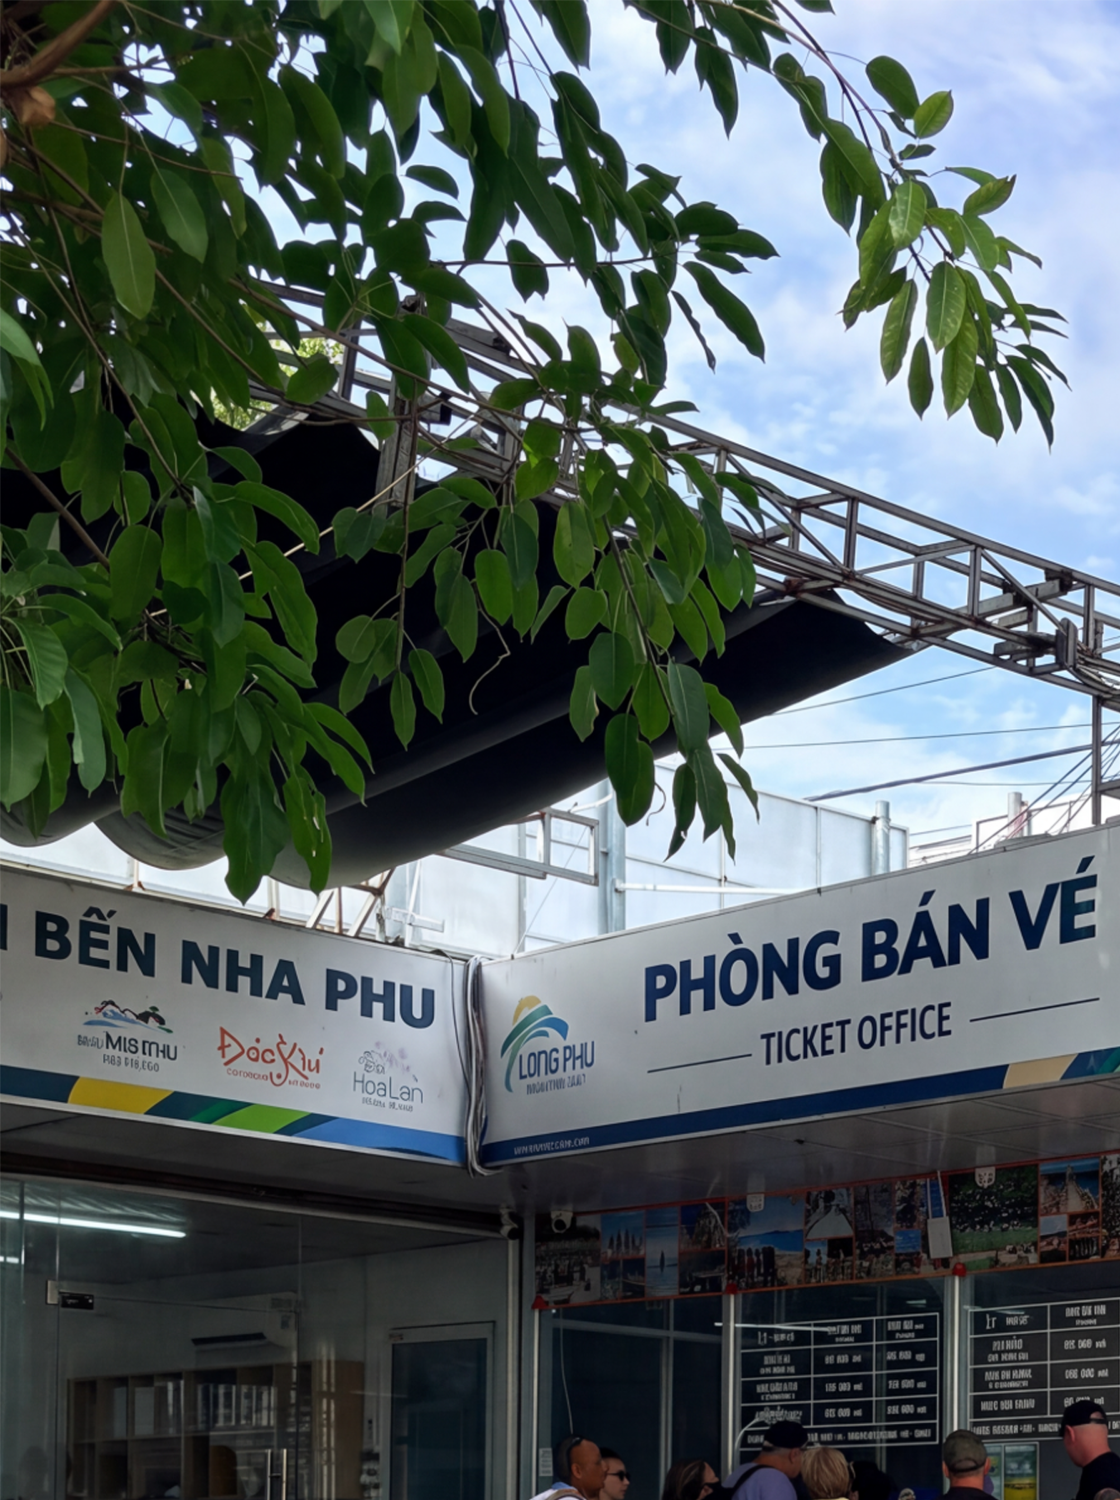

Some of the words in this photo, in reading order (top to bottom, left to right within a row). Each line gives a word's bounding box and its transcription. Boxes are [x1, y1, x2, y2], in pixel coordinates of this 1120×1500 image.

[34, 905, 157, 979] BẾN
[180, 939, 306, 1006] NHA
[325, 967, 436, 1029] PHU
[644, 931, 842, 1023] PHÒNG
[860, 889, 990, 982] BÁN
[1008, 855, 1099, 953] VÉ
[518, 1047, 560, 1080] LONG
[562, 1040, 595, 1073] PHU
[759, 1014, 851, 1067] TICKET
[857, 1000, 952, 1051] OFFICE
